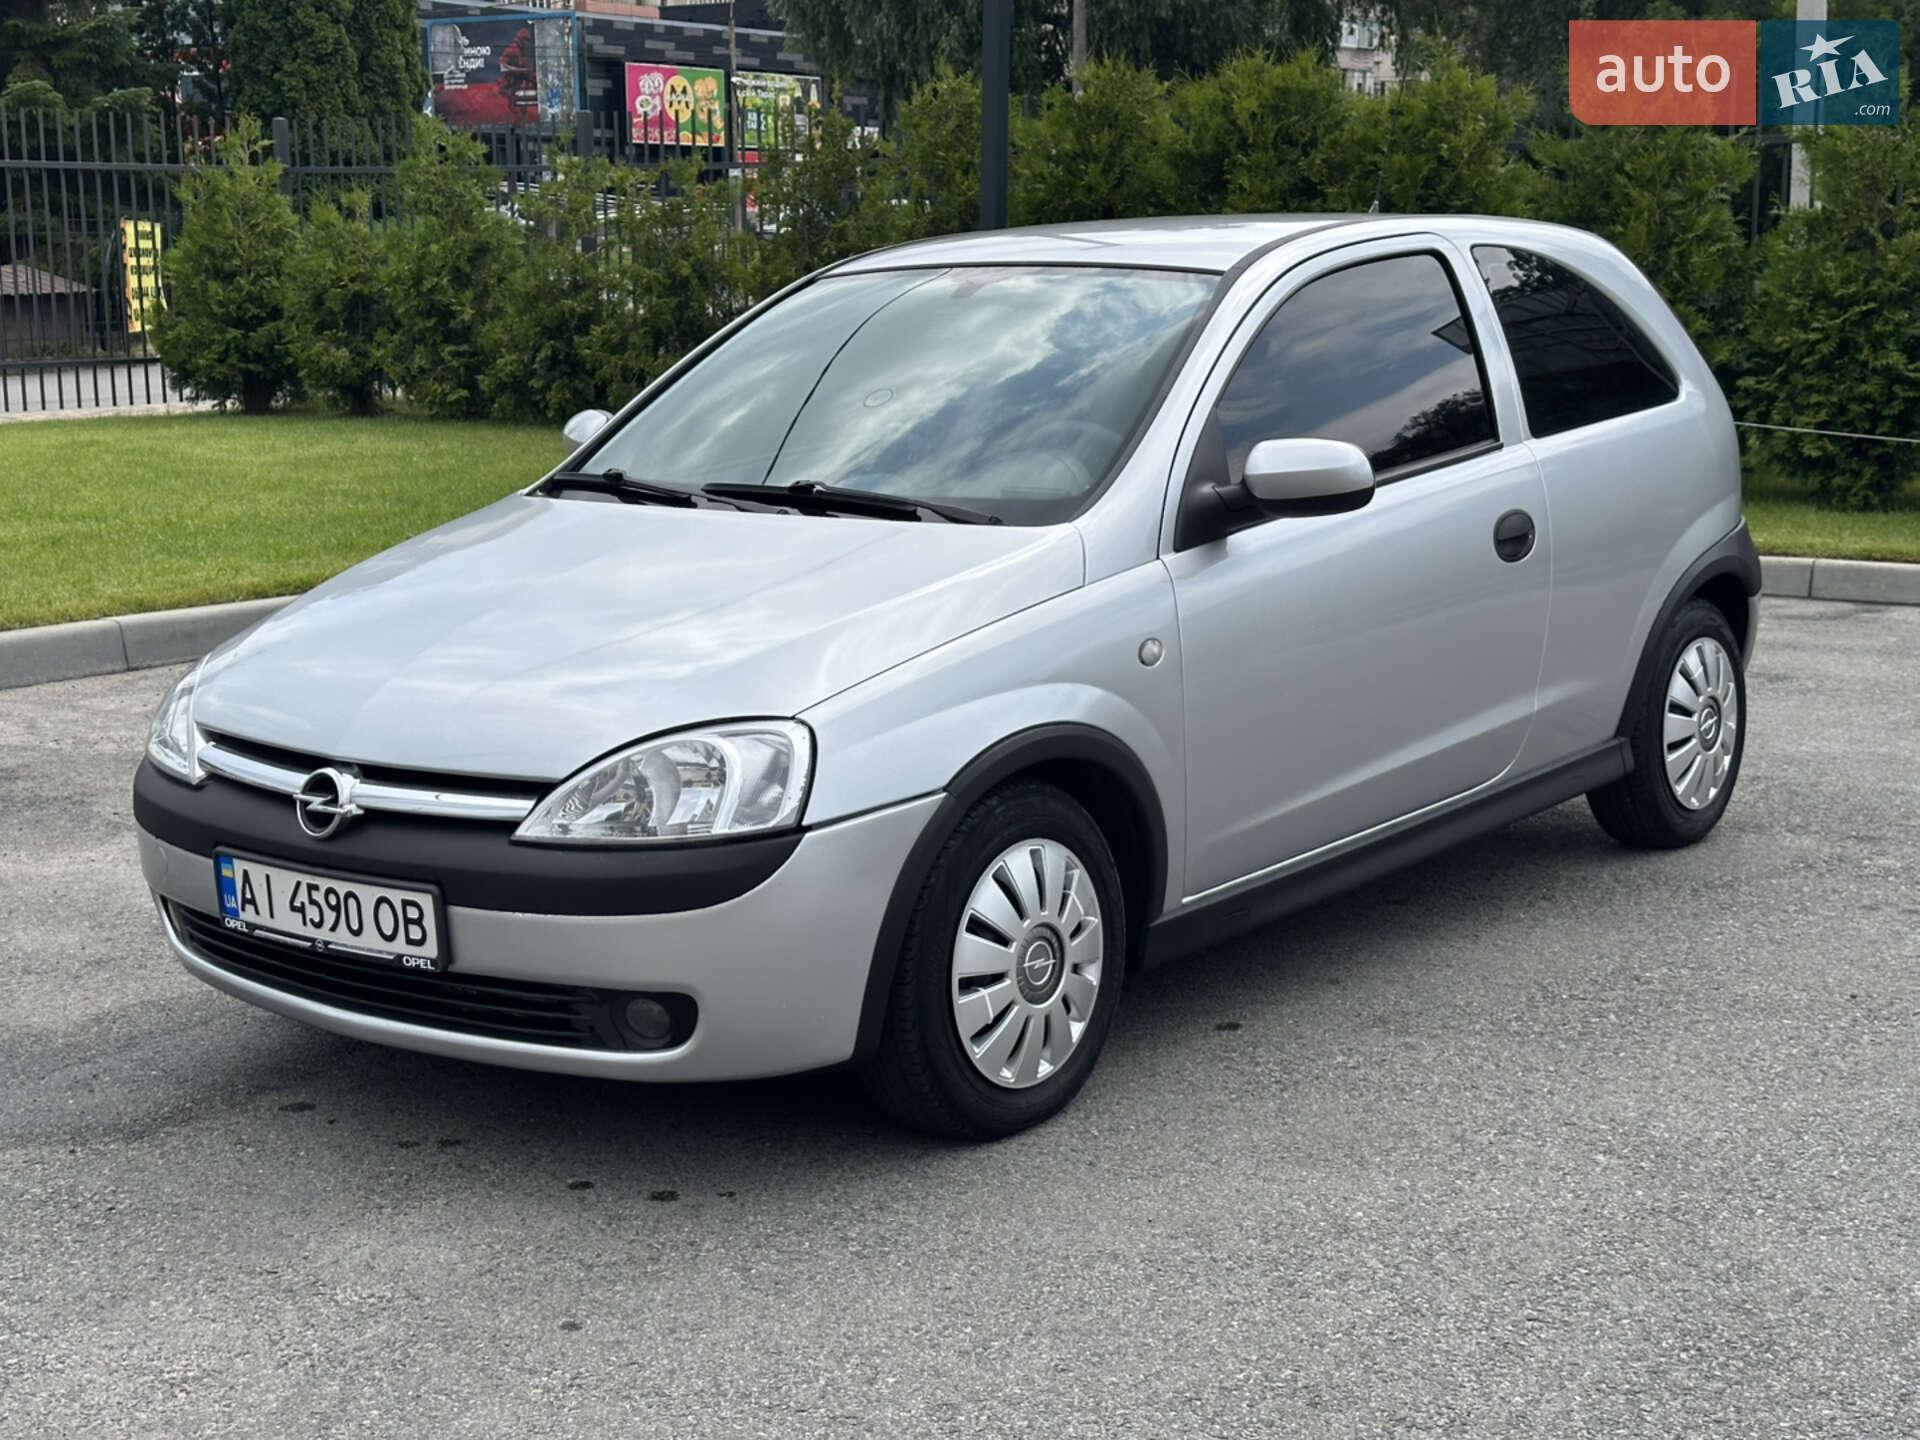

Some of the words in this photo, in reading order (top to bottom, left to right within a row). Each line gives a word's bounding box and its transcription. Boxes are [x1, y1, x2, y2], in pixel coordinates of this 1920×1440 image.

[224, 893, 238, 910] UA
[240, 868, 275, 919] AI
[289, 880, 364, 937] 4590
[373, 895, 428, 947] OB
[224, 917, 249, 933] OPEL
[402, 955, 435, 970] OPEL
